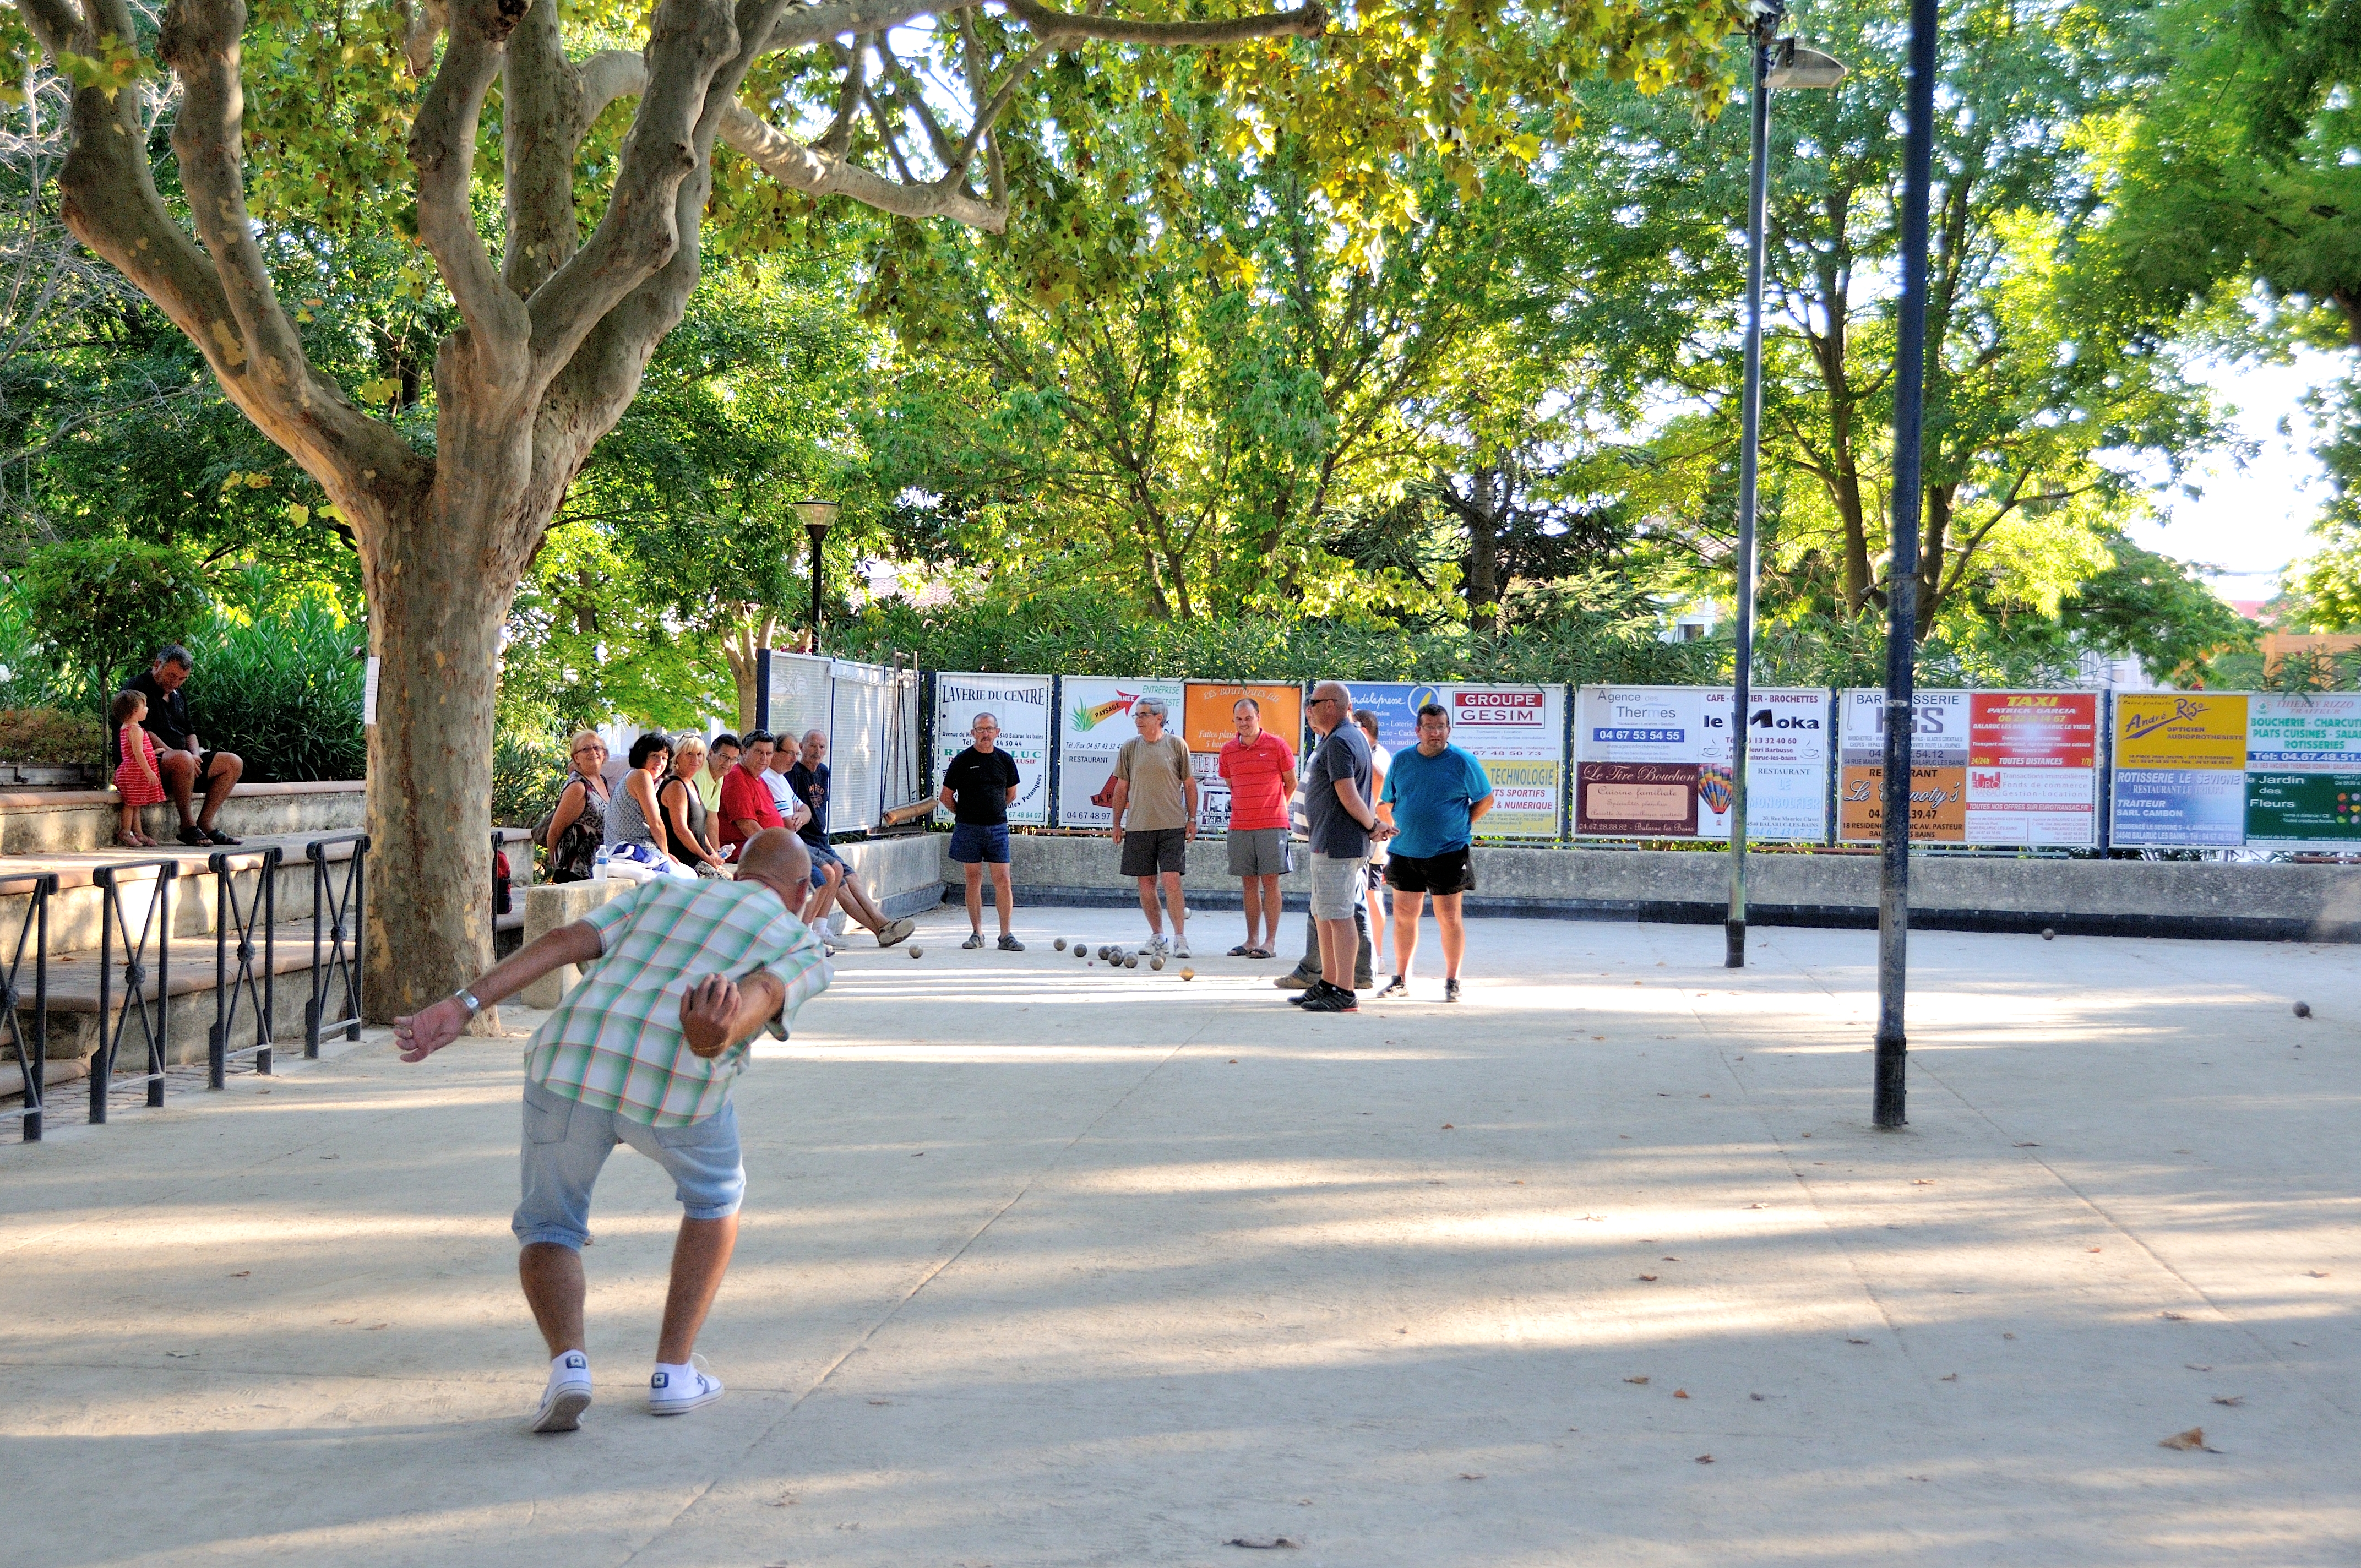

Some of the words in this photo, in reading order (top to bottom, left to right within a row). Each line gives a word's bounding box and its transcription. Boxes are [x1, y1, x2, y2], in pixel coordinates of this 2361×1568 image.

[943, 685, 986, 703] LAVERIE
[988, 690, 1002, 700] DU
[1004, 688, 1044, 705] CENTRE
[1142, 685, 1180, 694] ENTREPRISE
[1204, 689, 1217, 700] LES
[1220, 688, 1266, 698] BOUTIQUES
[1465, 695, 1535, 705] GROUPE
[1597, 690, 1641, 703] Agence
[1857, 695, 1882, 704] BAR
[1913, 695, 1959, 704] SSERIE
[2006, 696, 2059, 706] TAXI
[1095, 702, 1120, 718] PAYSAGE
[1461, 710, 1533, 721] GESIM
[1616, 706, 1675, 718] Thermes
[1704, 715, 1723, 727] le
[1731, 709, 1820, 731] Moka
[2125, 711, 2166, 732] André
[2251, 718, 2305, 727] BOUCHERIE
[1199, 730, 1217, 738] Faites
[1600, 731, 1613, 739] 04
[1616, 731, 1629, 739] 67
[1633, 731, 1646, 739] 53
[1649, 731, 1663, 740] 54
[1666, 732, 1679, 740] 55
[2253, 729, 2280, 738] PLATS
[2283, 729, 2326, 738] CUISINES
[2284, 741, 2345, 749] ROTISSERIES
[1198, 756, 1210, 772] LE
[1491, 768, 1554, 785] TECHNOLOGIE
[1581, 764, 1603, 781] Le
[1606, 765, 1634, 781] Tire
[1637, 765, 1695, 781] Bouchon
[1778, 778, 1791, 790] LE
[2118, 772, 2174, 783] ROTISSERIE
[2179, 774, 2191, 783] LE
[2197, 774, 2241, 785] SEVIGNE
[2259, 776, 2304, 784] Jardin
[1021, 774, 1042, 802] Petanques
[1598, 786, 1632, 796] Cuisine
[1635, 787, 1677, 798] familiale
[1844, 780, 1870, 801] Le
[2133, 785, 2182, 793] RESTAURANT
[2117, 799, 2166, 808] TRAITEUR
[2250, 799, 2295, 807] Fleurs
[1634, 822, 1662, 831] Balaruc
[1674, 823, 1694, 831] Bains
